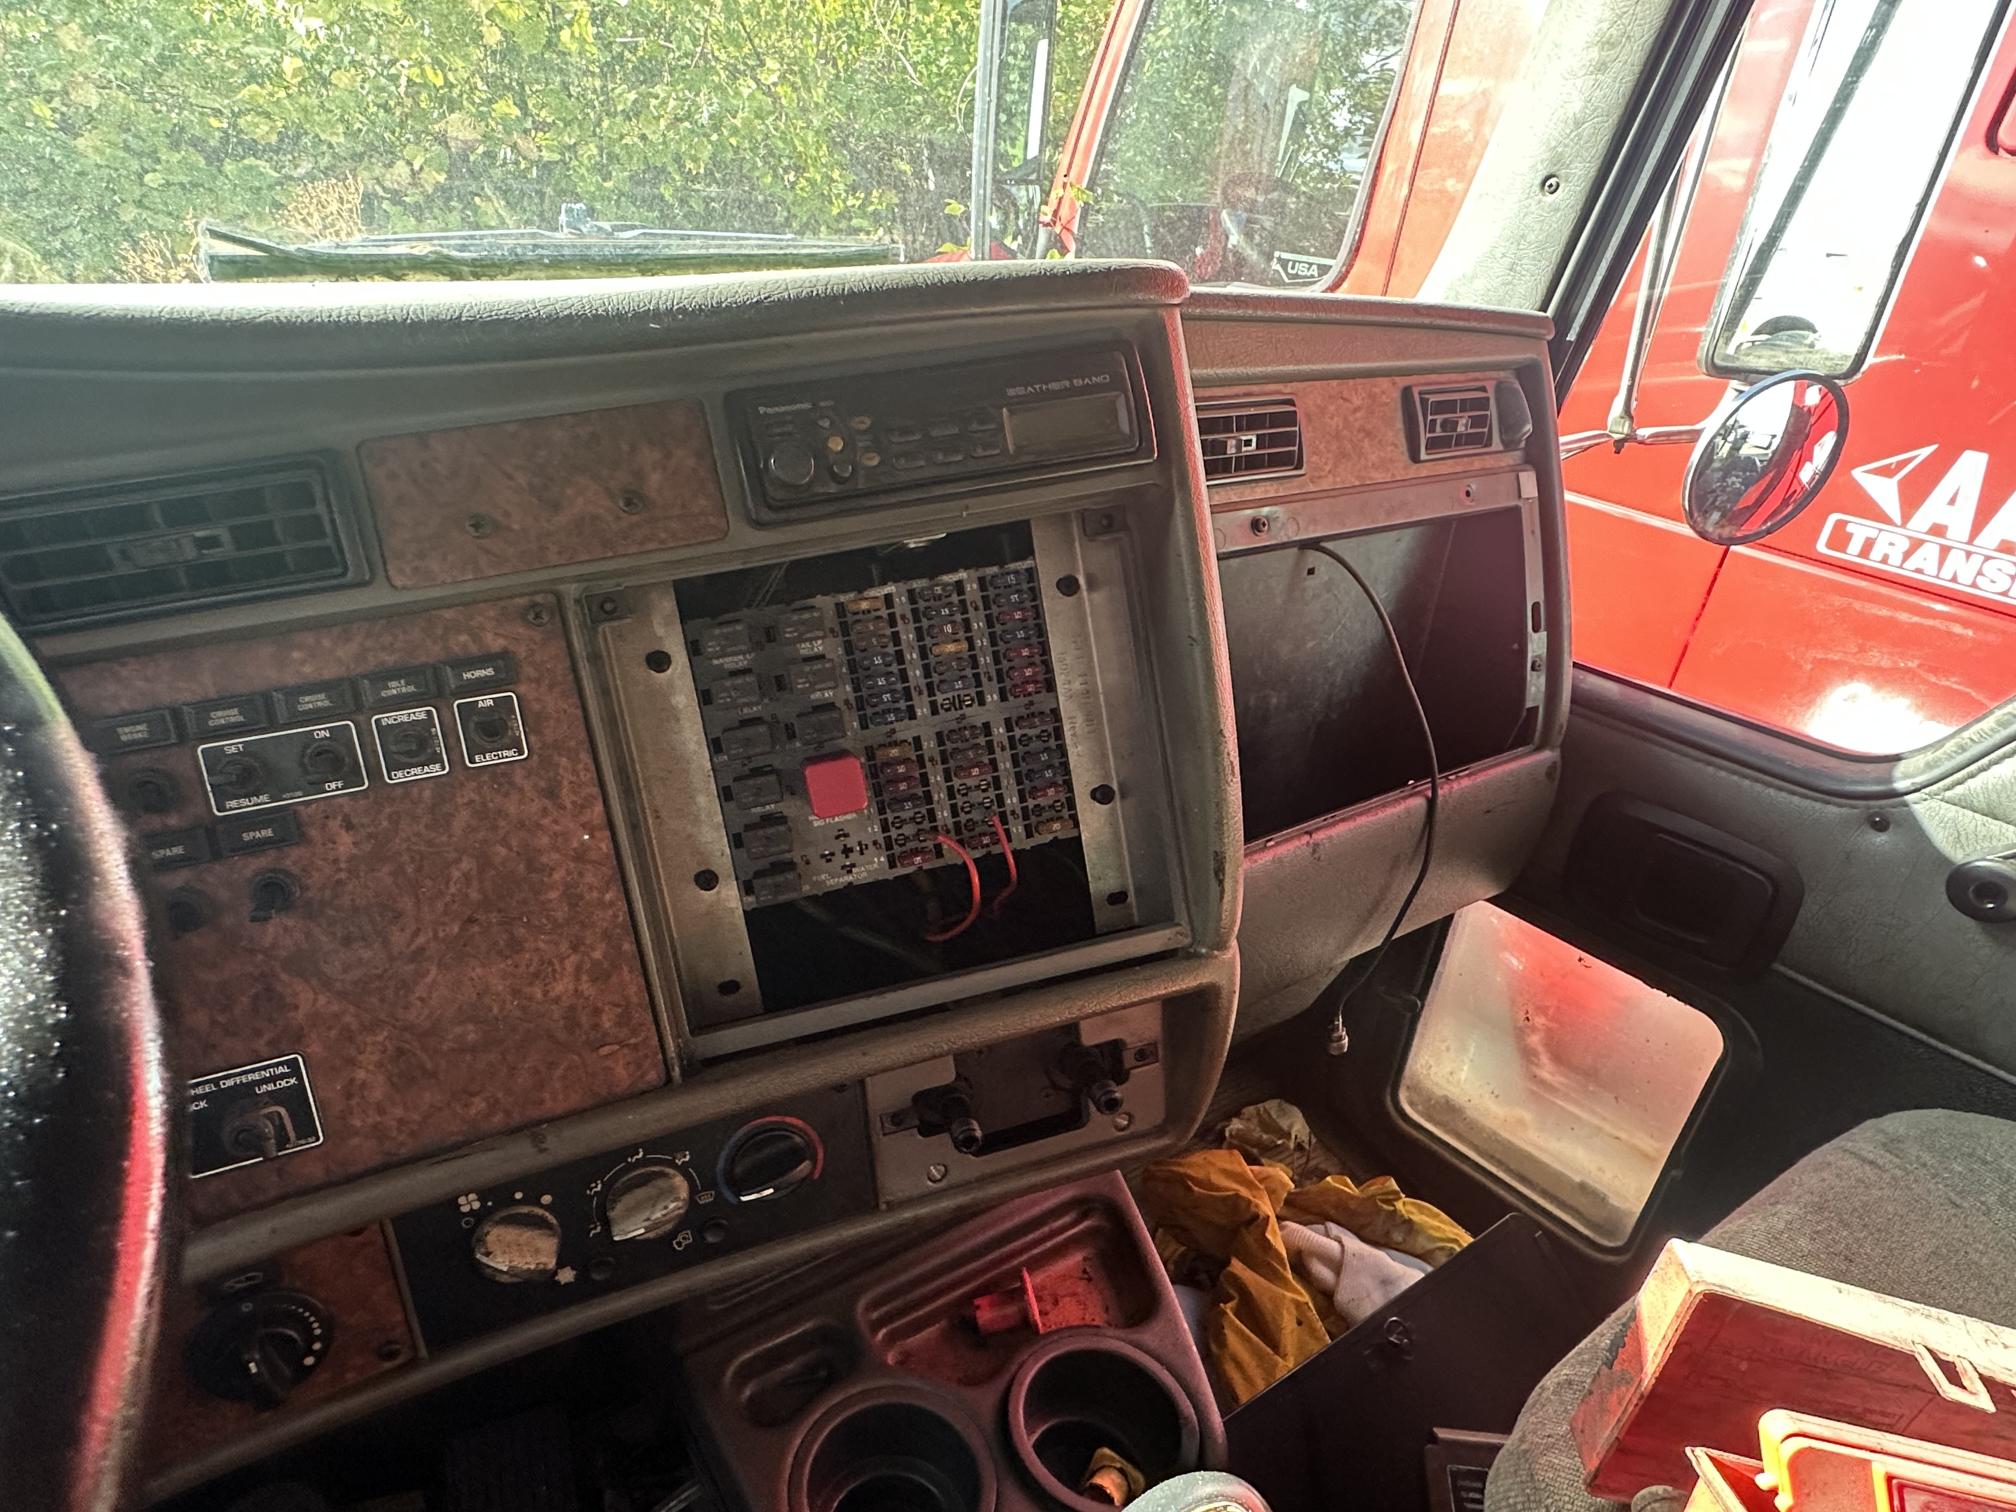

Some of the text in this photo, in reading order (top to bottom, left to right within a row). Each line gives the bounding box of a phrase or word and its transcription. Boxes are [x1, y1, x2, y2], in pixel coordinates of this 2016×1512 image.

[1287, 260, 1319, 278] USA
[1073, 374, 1111, 388] BAND
[1846, 522, 2016, 597] TRANS
[463, 667, 496, 680] HORNS
[381, 685, 417, 697] CONTROL
[297, 700, 334, 711] CONTROL
[477, 699, 494, 709] AIR
[381, 711, 429, 726] INCREASE
[314, 729, 331, 739] ON
[224, 744, 245, 755] SET
[475, 748, 519, 763] ELECTRIC
[391, 763, 443, 780] DECREASE
[325, 780, 345, 792] OFF
[225, 793, 272, 810] RESUME
[241, 828, 275, 842] SPARE
[151, 845, 185, 860] SPARE
[188, 1064, 292, 1097] HEEL DIFFERENTIAL
[255, 1076, 299, 1095] UNLOCK
[190, 1098, 209, 1112] CK
